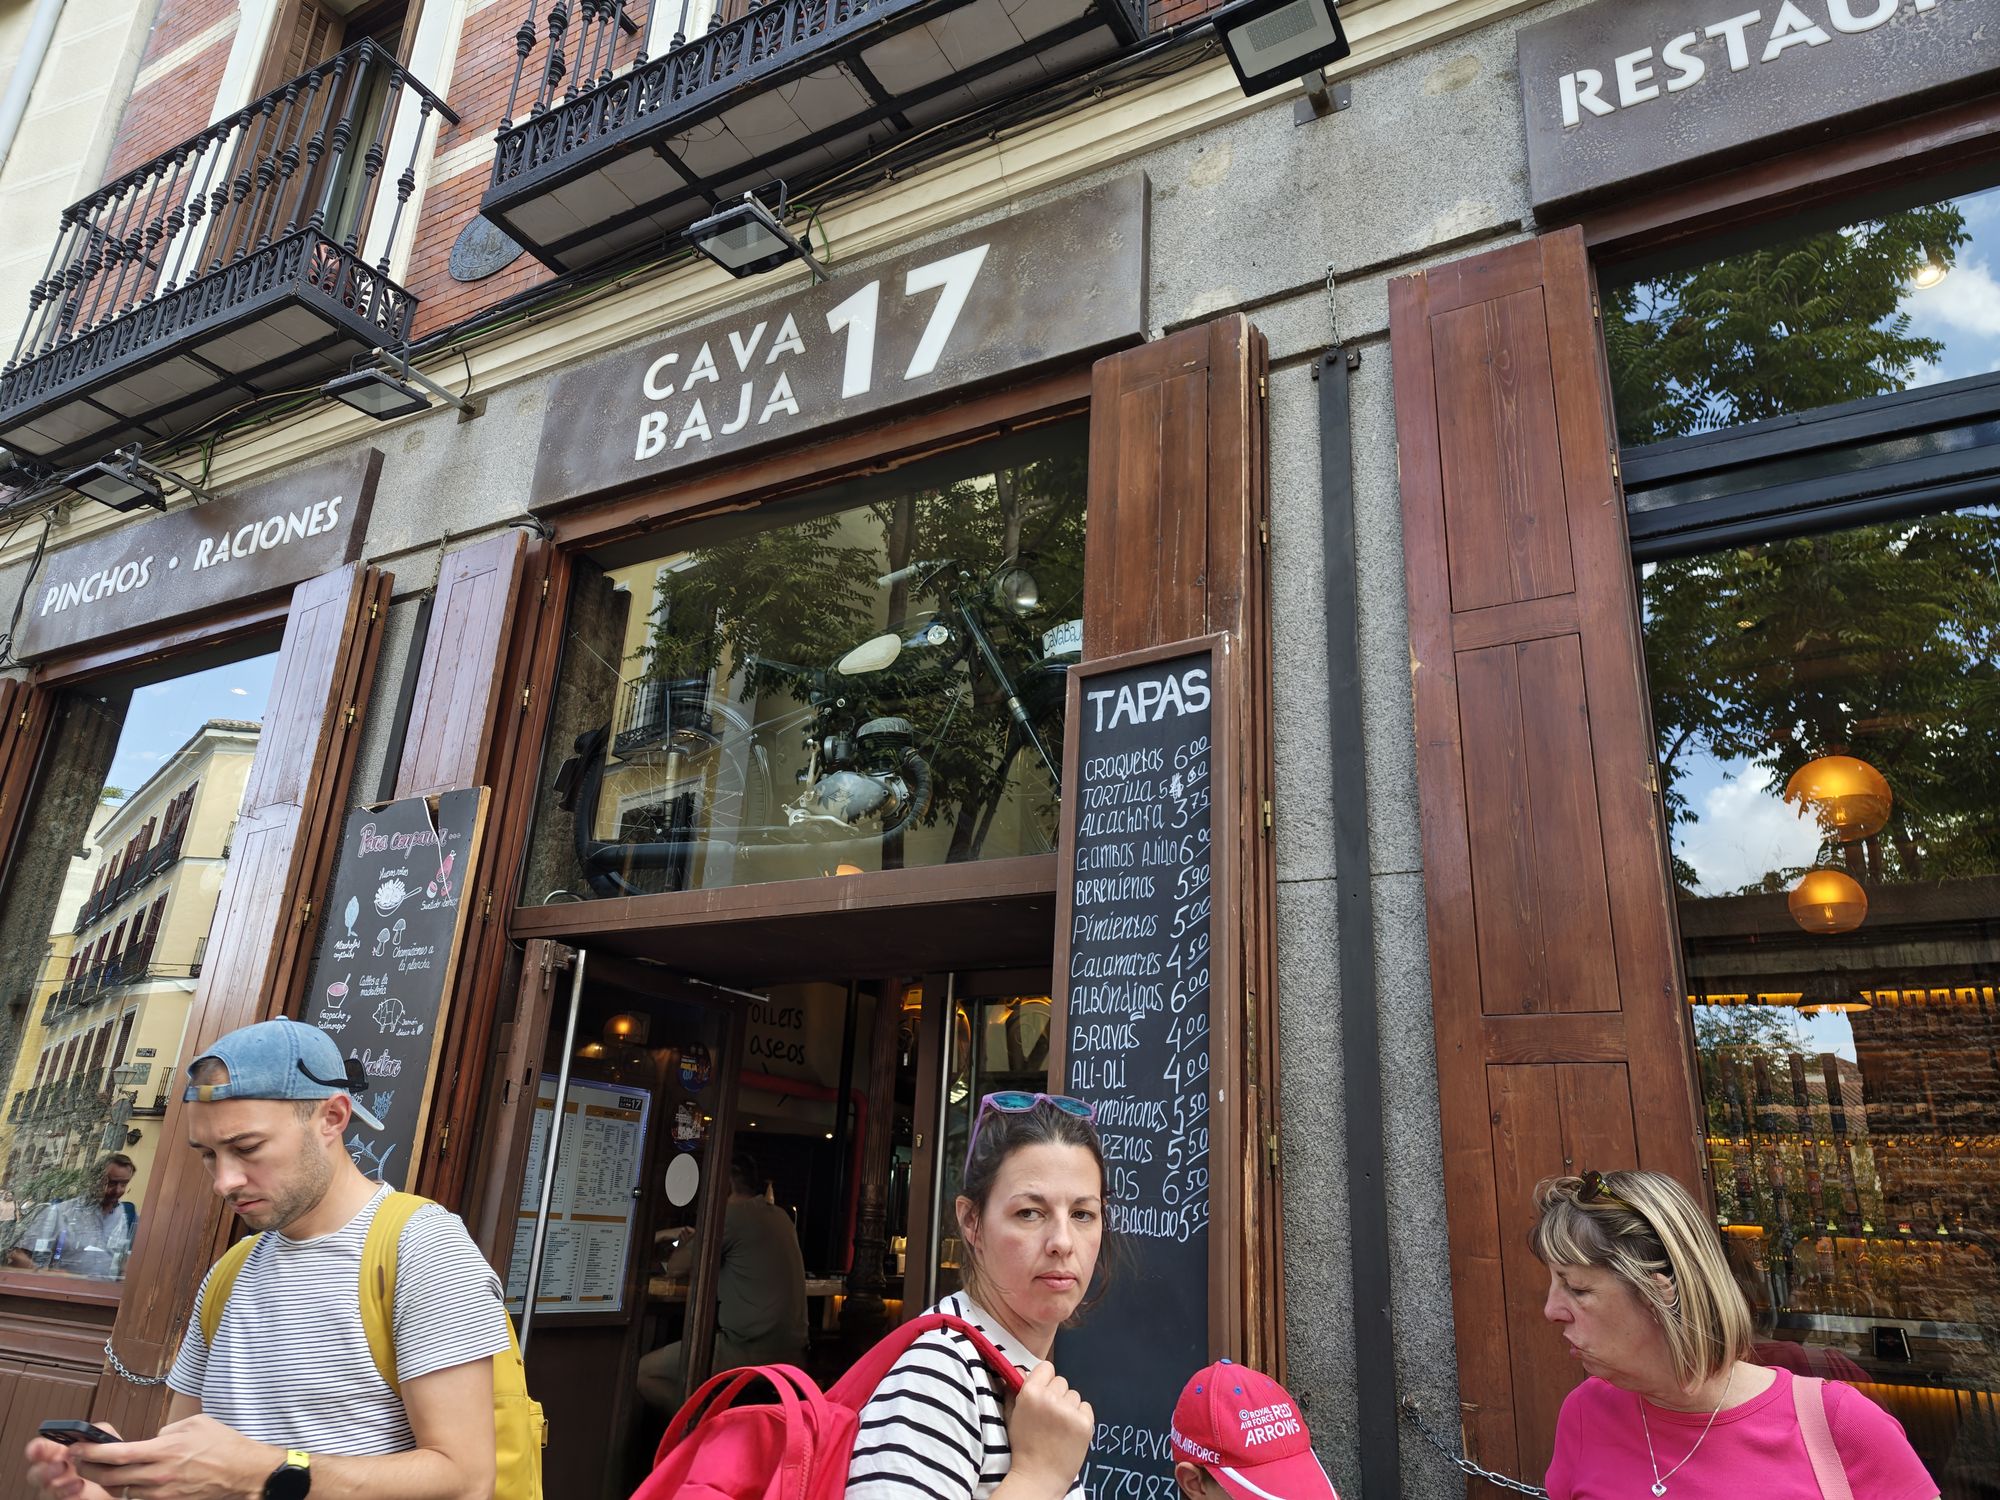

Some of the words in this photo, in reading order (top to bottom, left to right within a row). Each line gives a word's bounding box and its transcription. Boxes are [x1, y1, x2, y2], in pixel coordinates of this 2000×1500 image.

[1558, 0, 1936, 129] RESTAU
[826, 243, 990, 399] 17
[641, 312, 806, 401] CAVA
[633, 371, 801, 461] BAJA
[41, 555, 154, 617] PINCHOS
[193, 496, 343, 571] RACIONES
[1087, 668, 1211, 732] TAPAS
[631, 1099, 642, 1110] 17
[1240, 1420, 1253, 1430] AIR
[1252, 1414, 1275, 1427] FORCE
[1245, 1418, 1300, 1447] ARROWS
[1249, 1406, 1272, 1419] ROYAL
[1271, 1403, 1293, 1420] RED
[1192, 1442, 1221, 1465] FORCE
